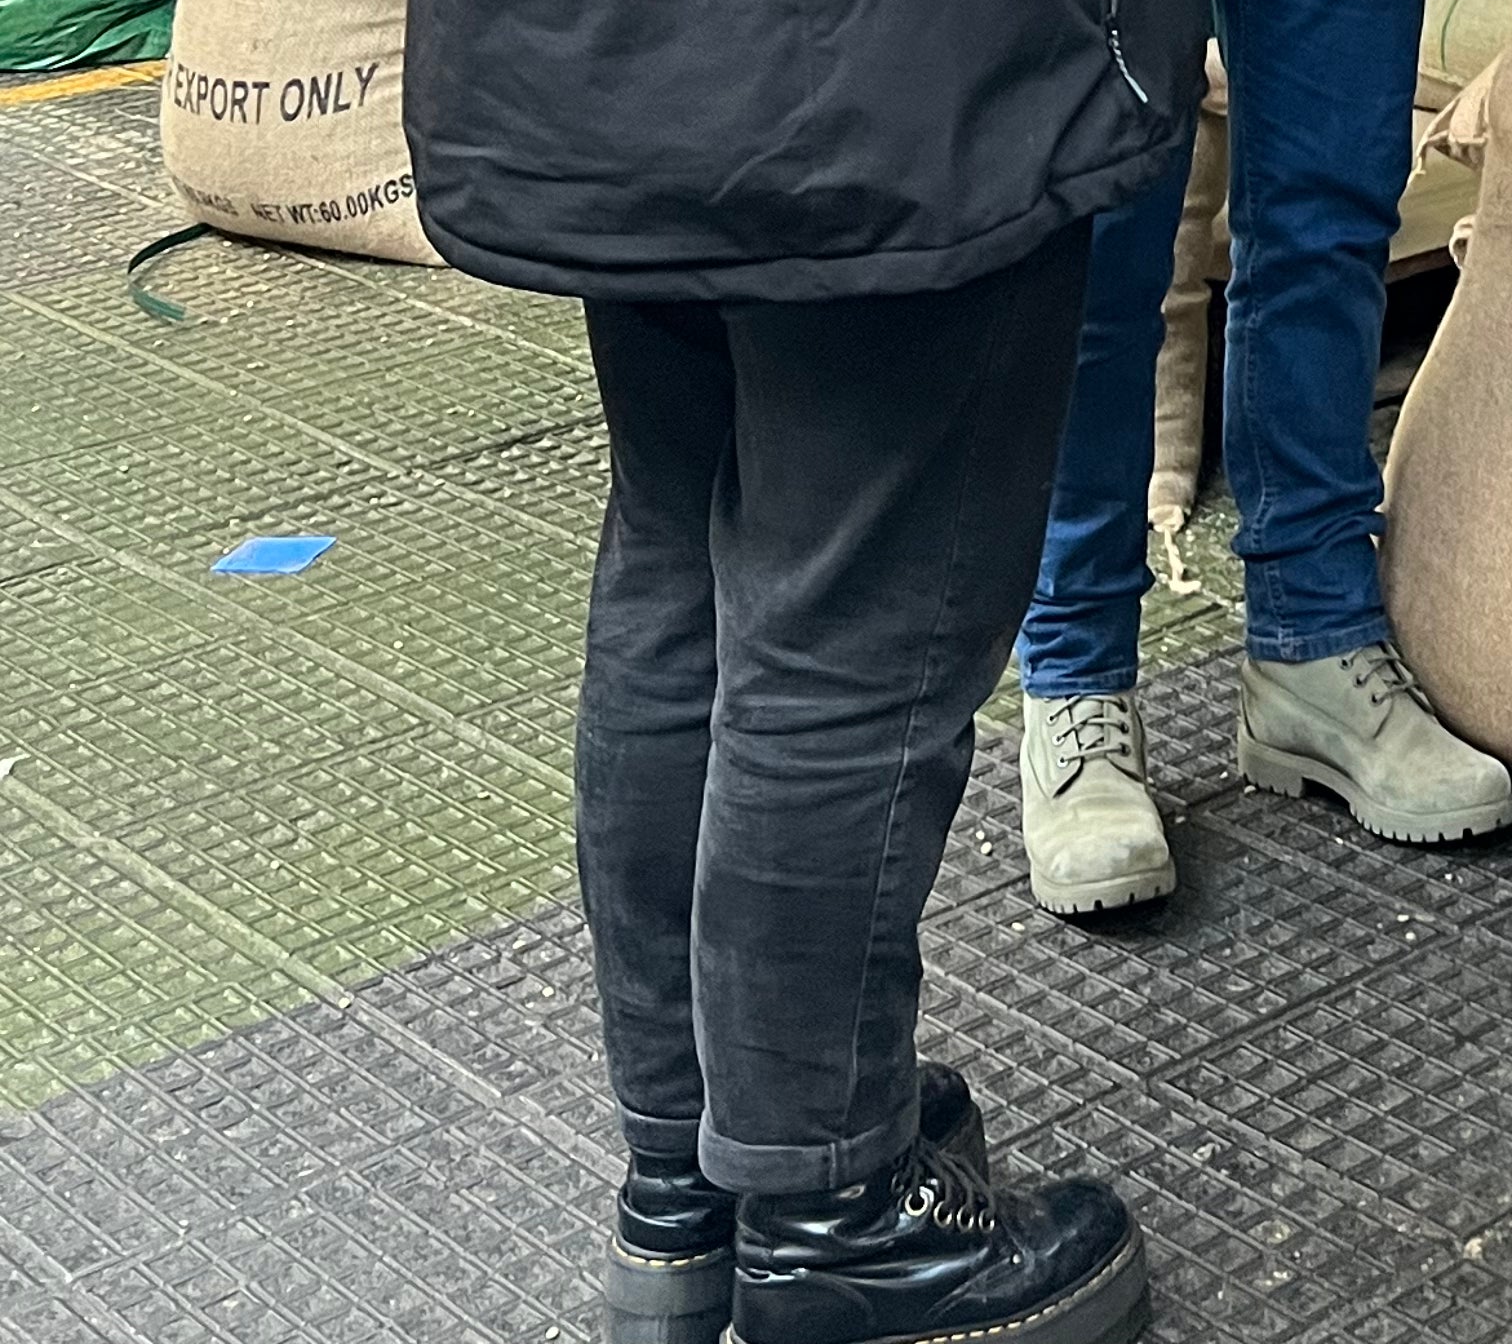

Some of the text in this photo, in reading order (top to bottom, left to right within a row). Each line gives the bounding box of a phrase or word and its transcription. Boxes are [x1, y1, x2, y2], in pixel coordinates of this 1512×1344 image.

[173, 62, 270, 126] EXPORT
[279, 62, 380, 123] ONLY
[250, 202, 283, 223] NET
